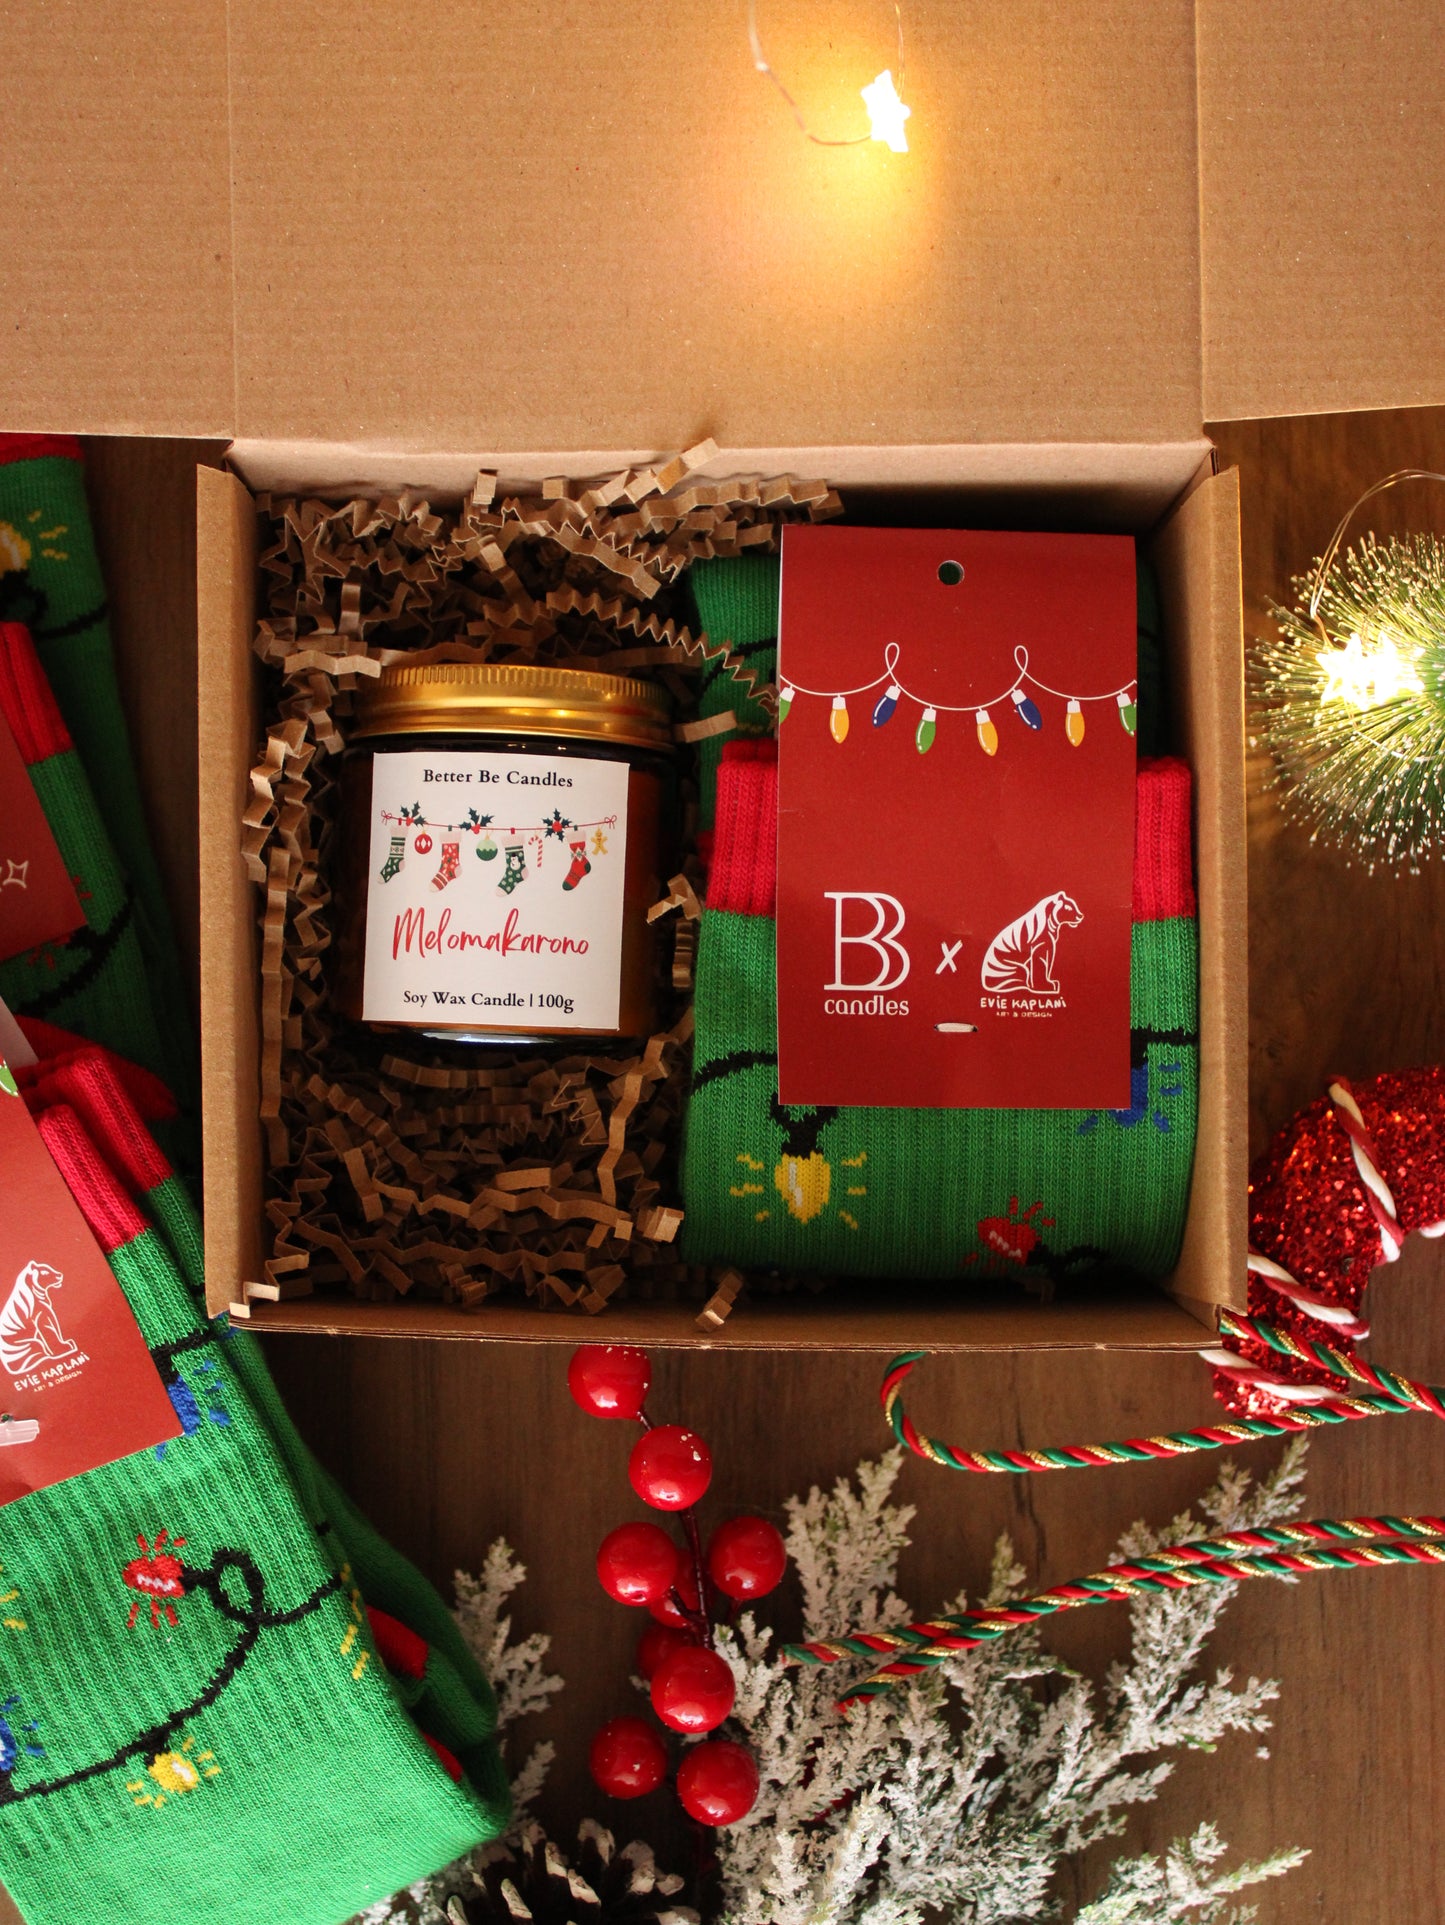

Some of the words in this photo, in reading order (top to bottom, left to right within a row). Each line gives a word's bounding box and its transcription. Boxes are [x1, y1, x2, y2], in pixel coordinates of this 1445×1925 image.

[423, 769, 473, 782] Better
[478, 769, 500, 783] Be
[506, 770, 573, 788] Candles
[392, 906, 590, 961] Melomakarono
[403, 990, 428, 1008] Soy
[432, 991, 467, 1005] Wax
[471, 992, 525, 1007] Candle
[538, 994, 575, 1014] 100g
[824, 995, 910, 1016] candles
